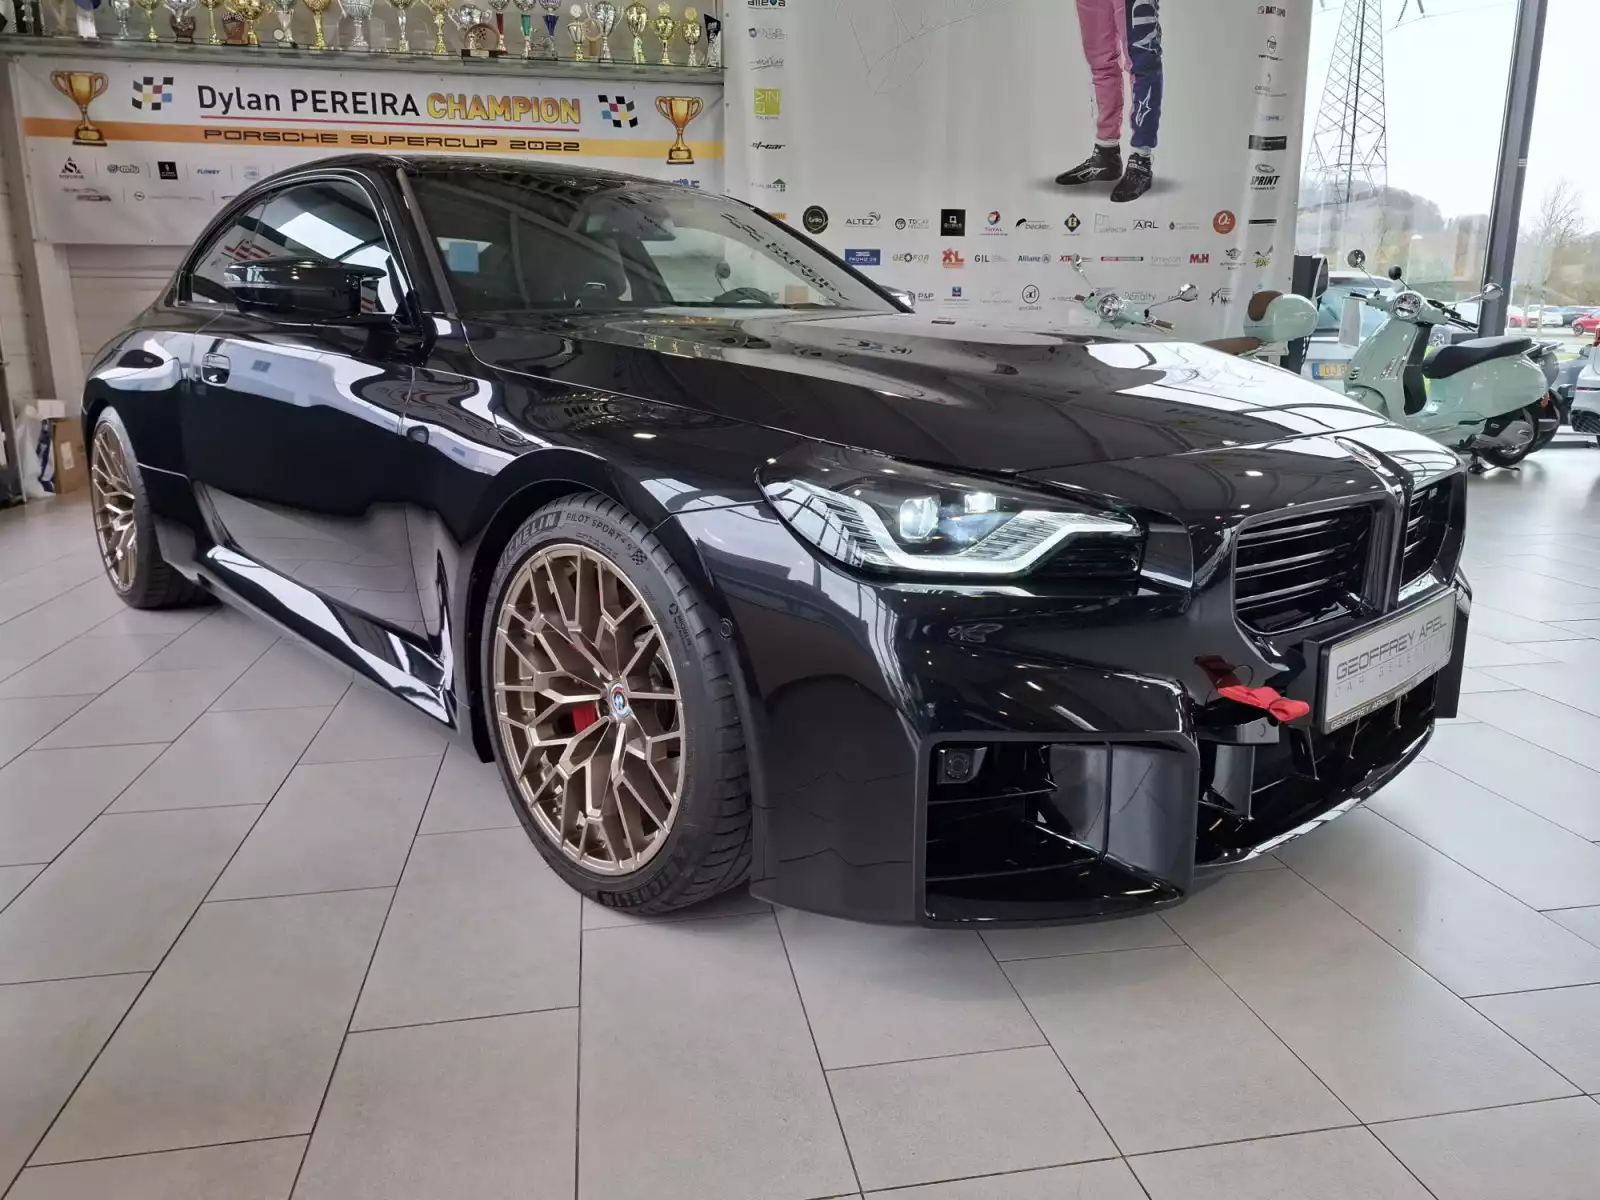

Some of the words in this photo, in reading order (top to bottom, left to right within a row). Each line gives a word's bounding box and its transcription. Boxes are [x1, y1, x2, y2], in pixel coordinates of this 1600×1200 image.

[198, 85, 281, 115] Dylan
[291, 89, 420, 117] PEREIRA
[426, 93, 582, 124] CHAMPION
[204, 129, 338, 143] PORSCHE
[351, 134, 498, 149] SUPERCUP
[509, 140, 580, 152] 2022
[1250, 176, 1280, 185] SPRINT
[846, 217, 874, 225] ALTEZ
[1134, 220, 1159, 229] ARL
[565, 511, 589, 524] PILOT
[591, 518, 621, 541] SPORT
[1336, 629, 1415, 680] GEOFFREY
[1418, 615, 1448, 640] APEL
[1331, 706, 1370, 730] GEOFFREY
[1372, 697, 1390, 712] APEL
